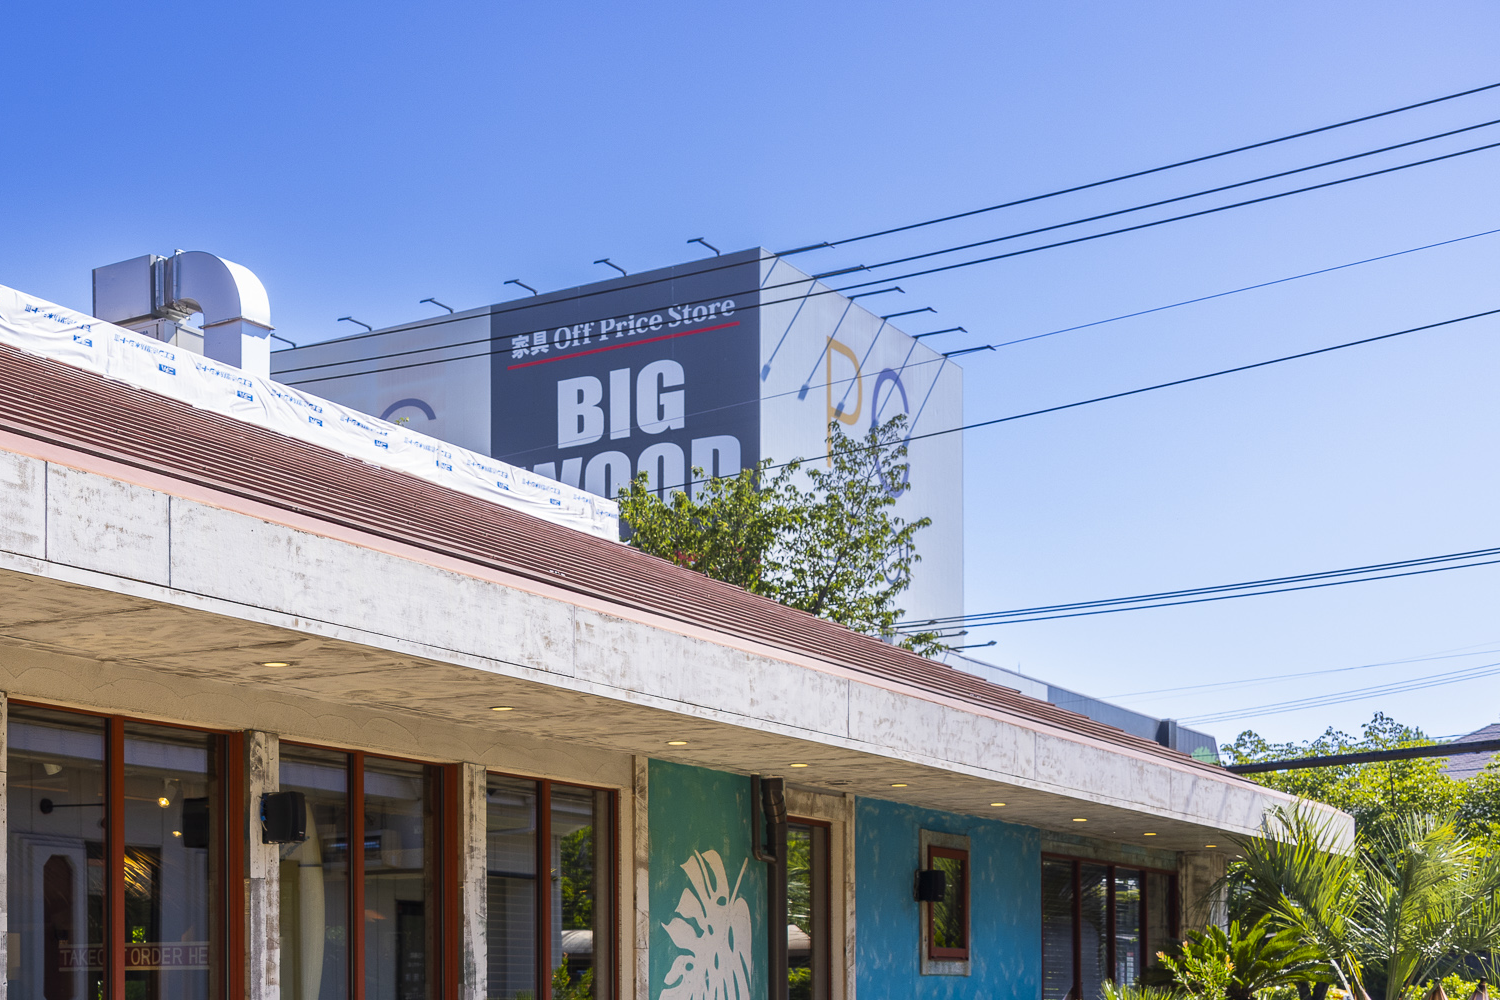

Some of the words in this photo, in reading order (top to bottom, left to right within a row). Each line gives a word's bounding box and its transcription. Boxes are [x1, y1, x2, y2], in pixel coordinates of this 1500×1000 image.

[511, 330, 550, 359] 家具
[553, 321, 595, 350] Off
[599, 314, 663, 342] Price
[668, 299, 736, 327] Store
[557, 359, 685, 449] BIG
[131, 947, 182, 966] ORDER
